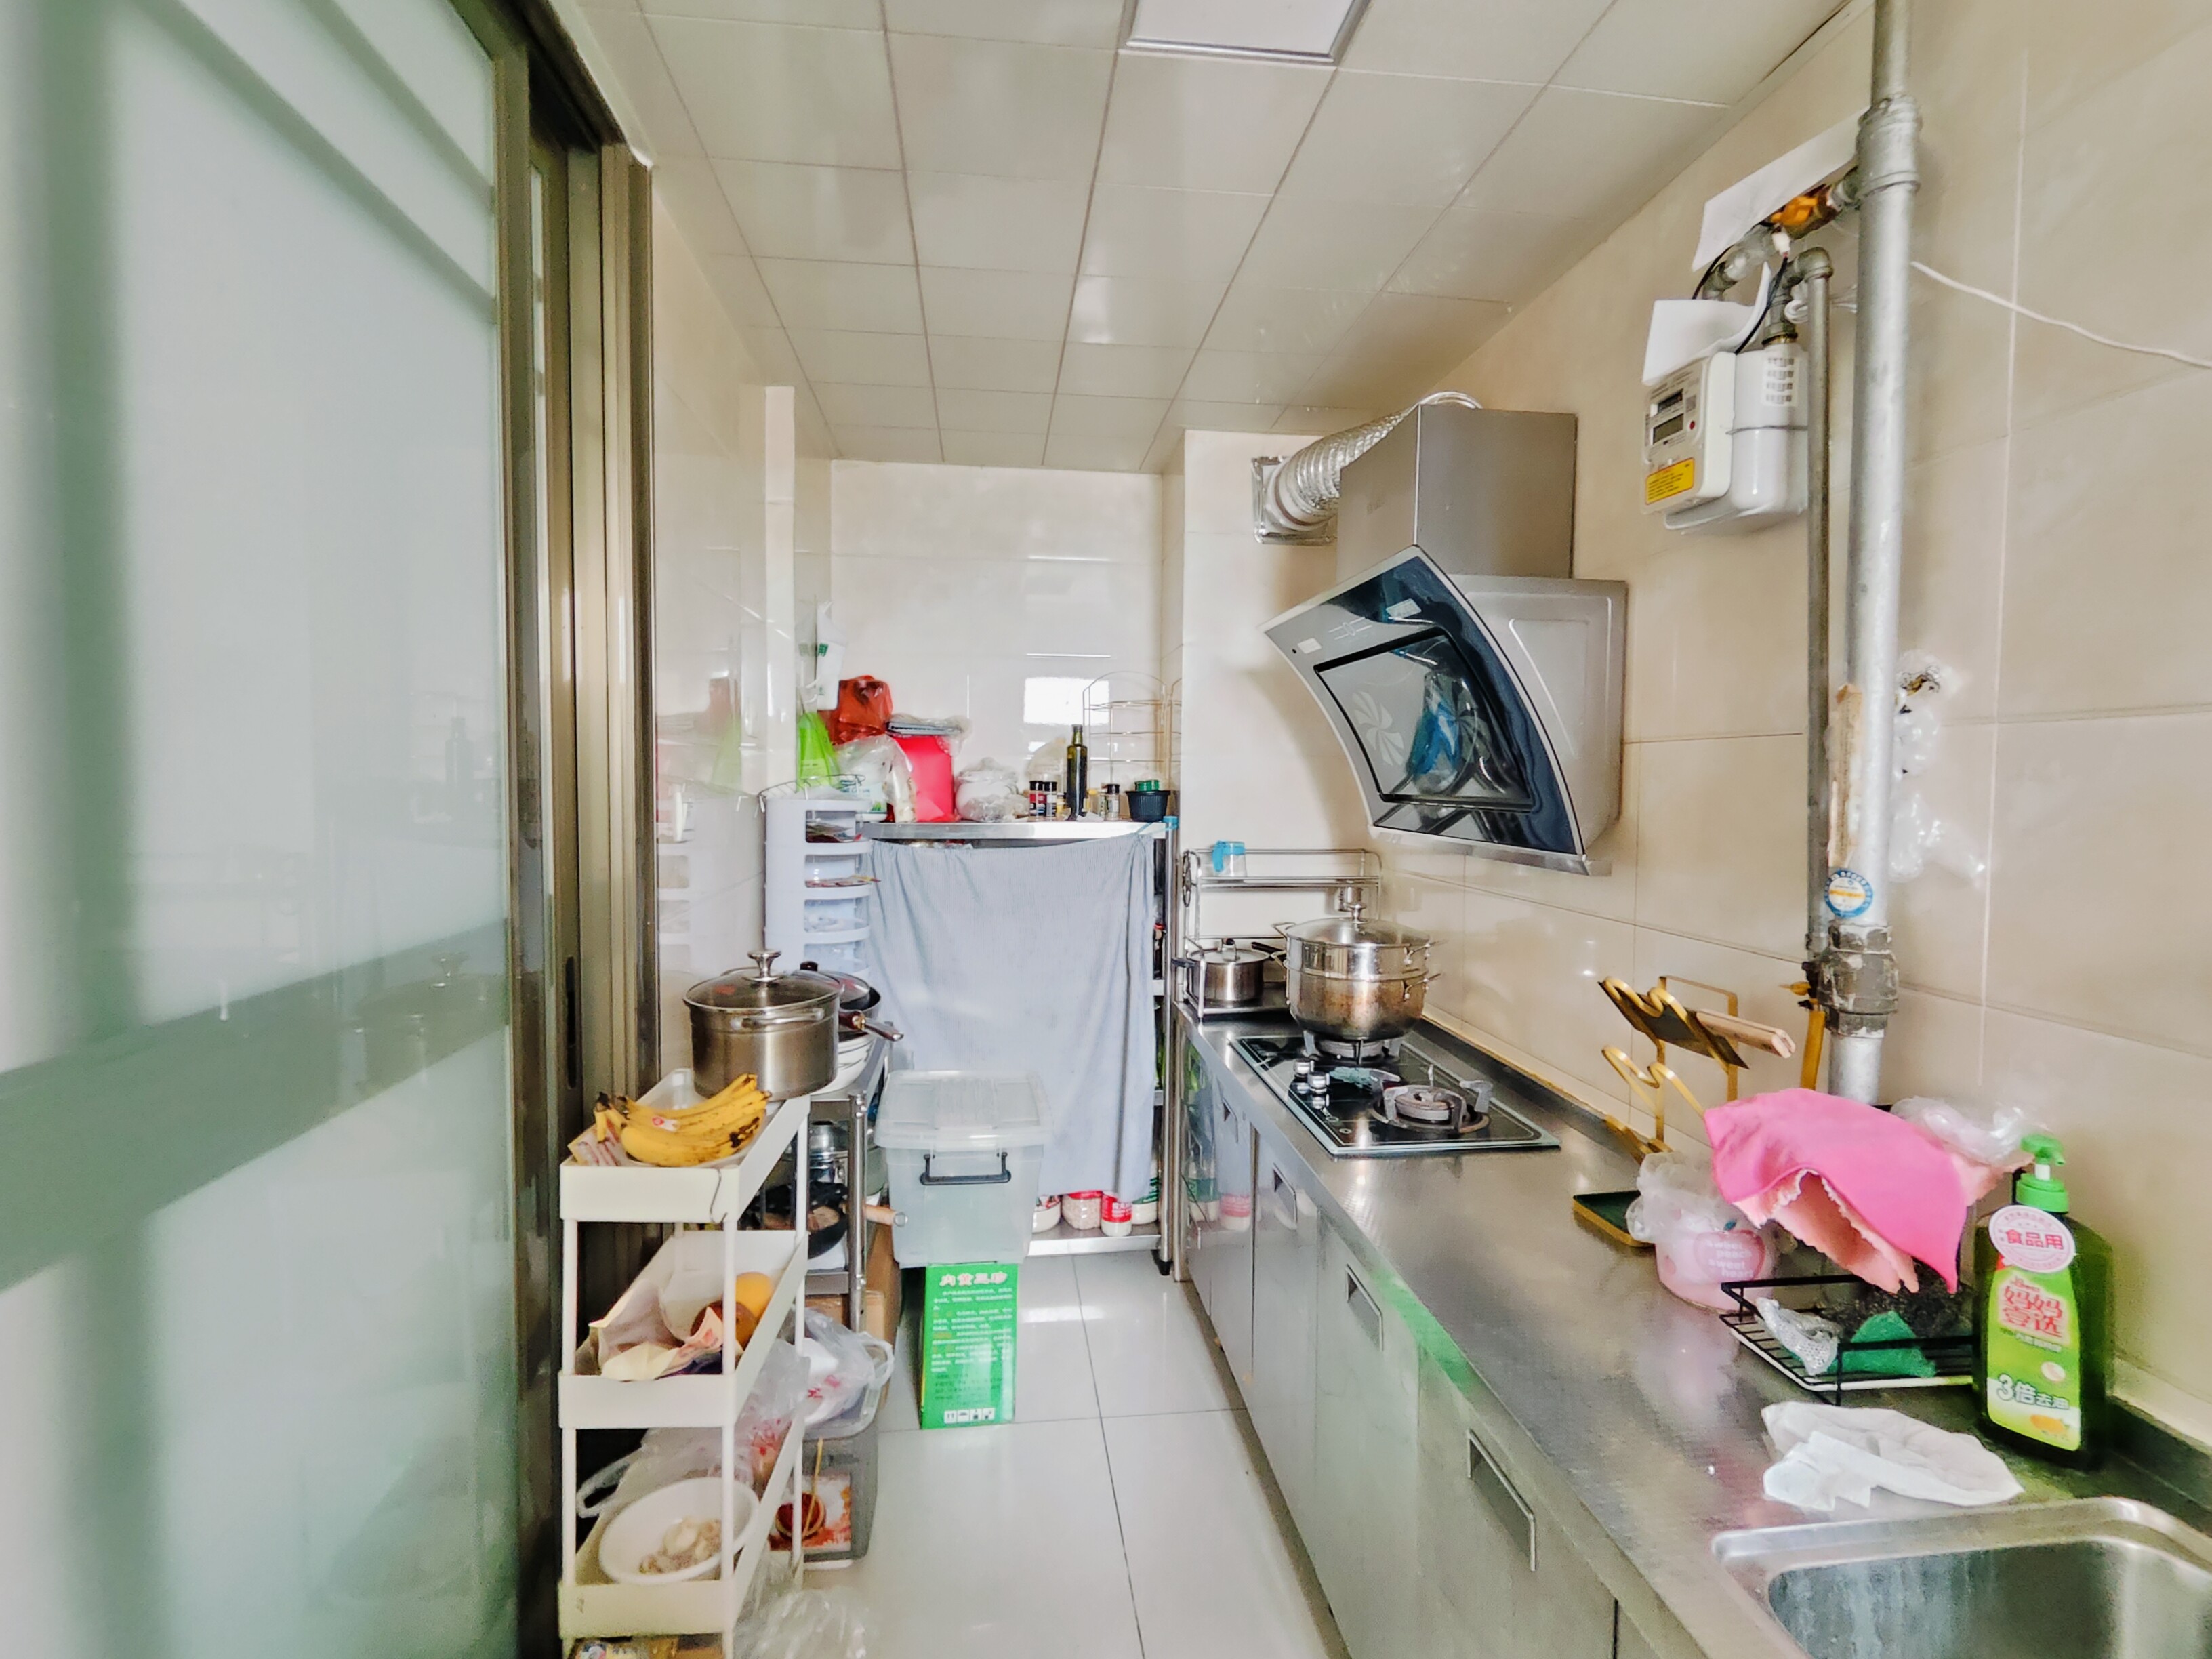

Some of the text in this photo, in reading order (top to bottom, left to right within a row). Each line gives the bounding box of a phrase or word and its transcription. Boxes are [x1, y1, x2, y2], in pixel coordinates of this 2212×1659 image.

[2006, 1228, 2064, 1250] 食品用
[1708, 1258, 1746, 1270] sweet
[2003, 1284, 2063, 1319] 妈妈
[2001, 1305, 2063, 1338] 壹选
[1996, 1372, 2070, 1410] 3倍去油
